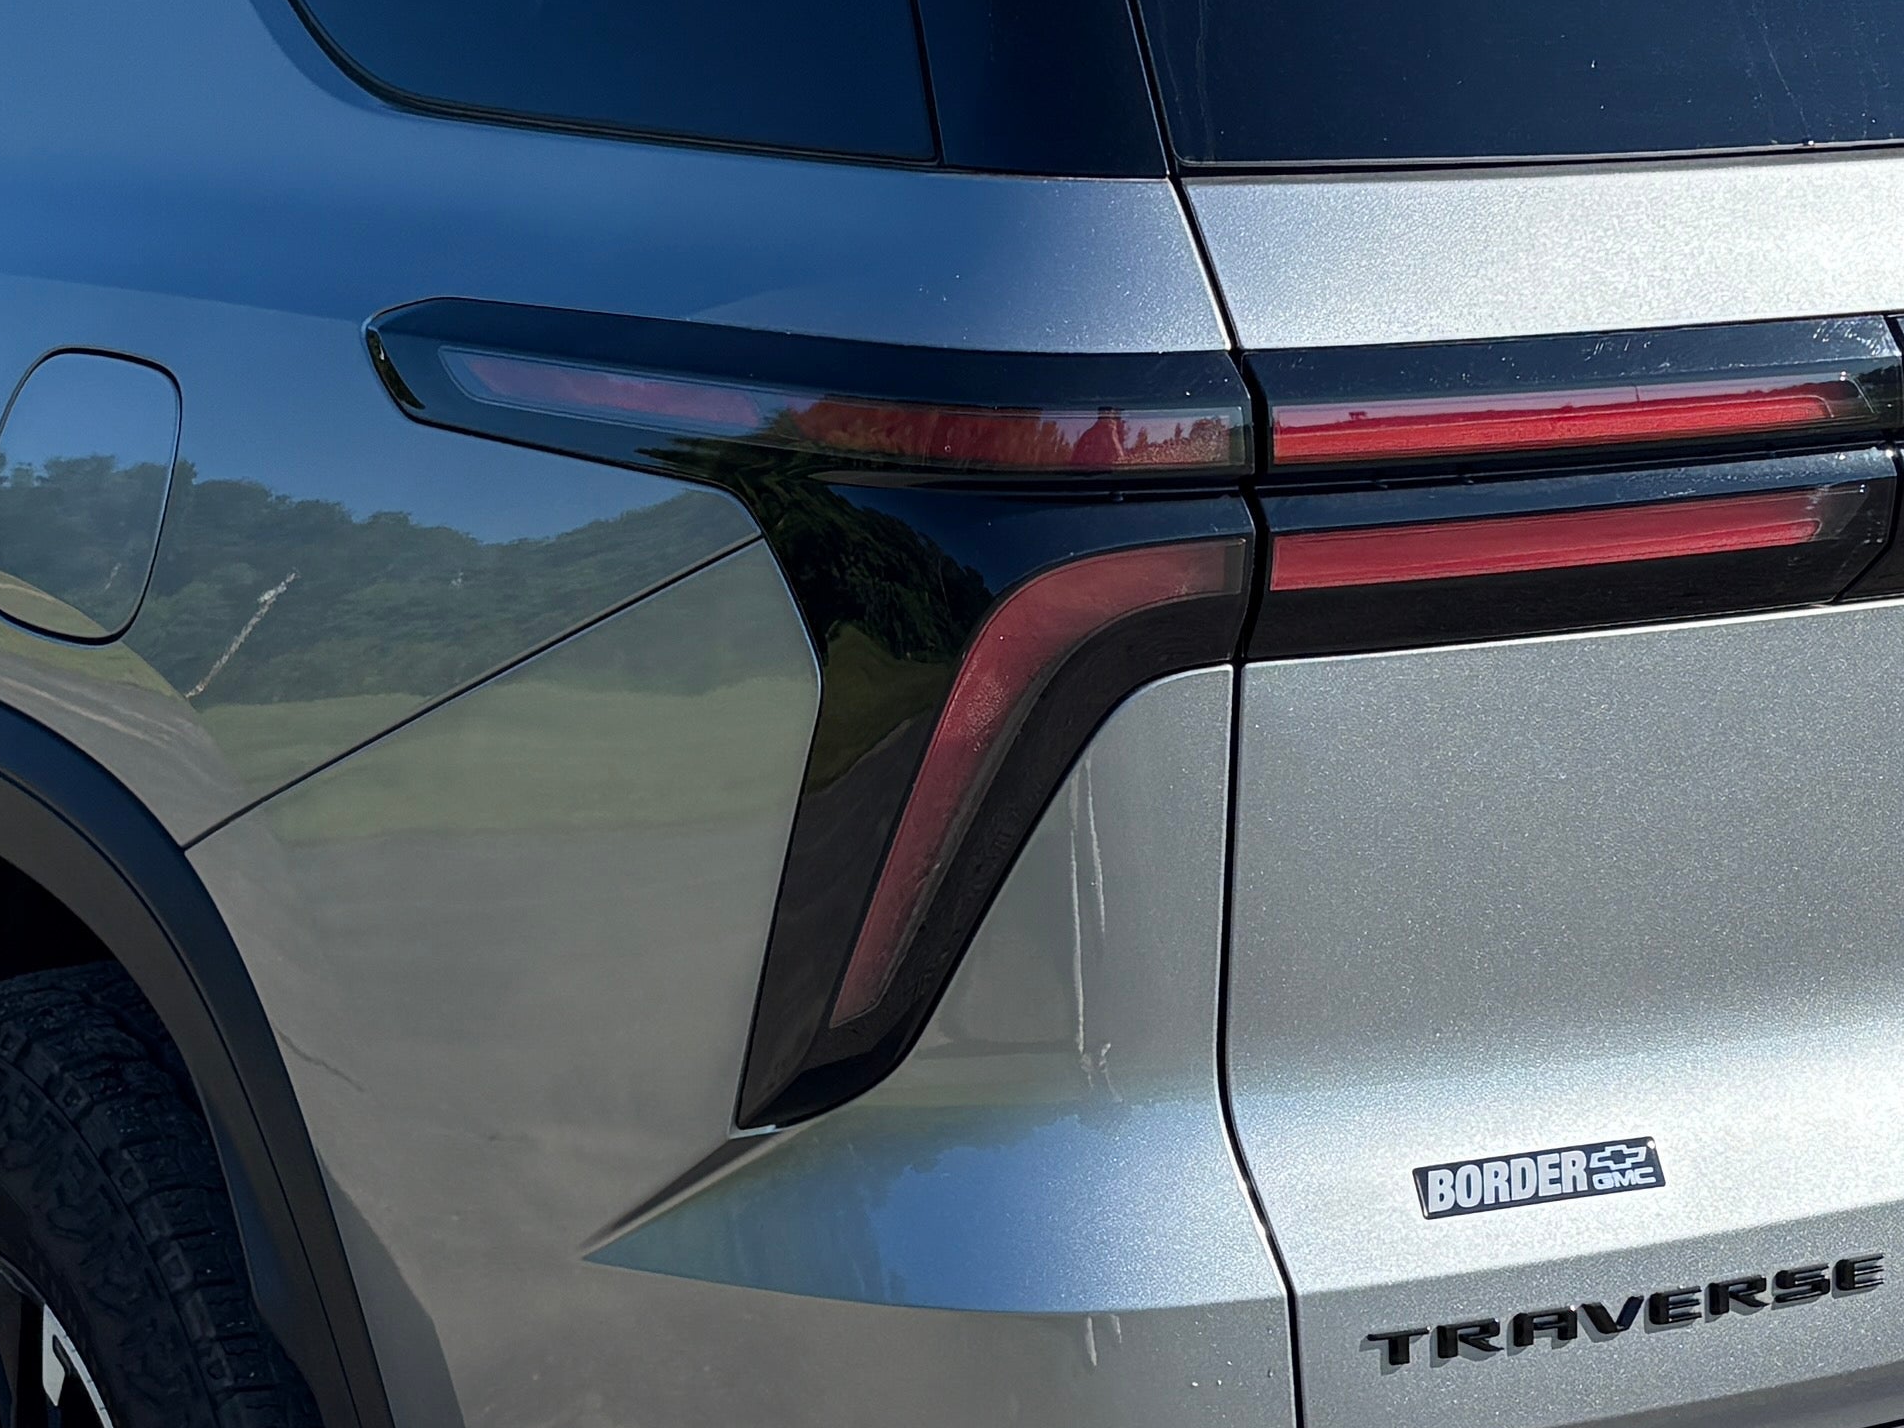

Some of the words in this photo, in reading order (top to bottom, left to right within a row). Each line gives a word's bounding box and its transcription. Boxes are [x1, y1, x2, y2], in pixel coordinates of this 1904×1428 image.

[1427, 1150, 1589, 1213] BORDER
[1592, 1167, 1657, 1190] GMC
[1366, 1253, 1885, 1367] TRAVERSE
